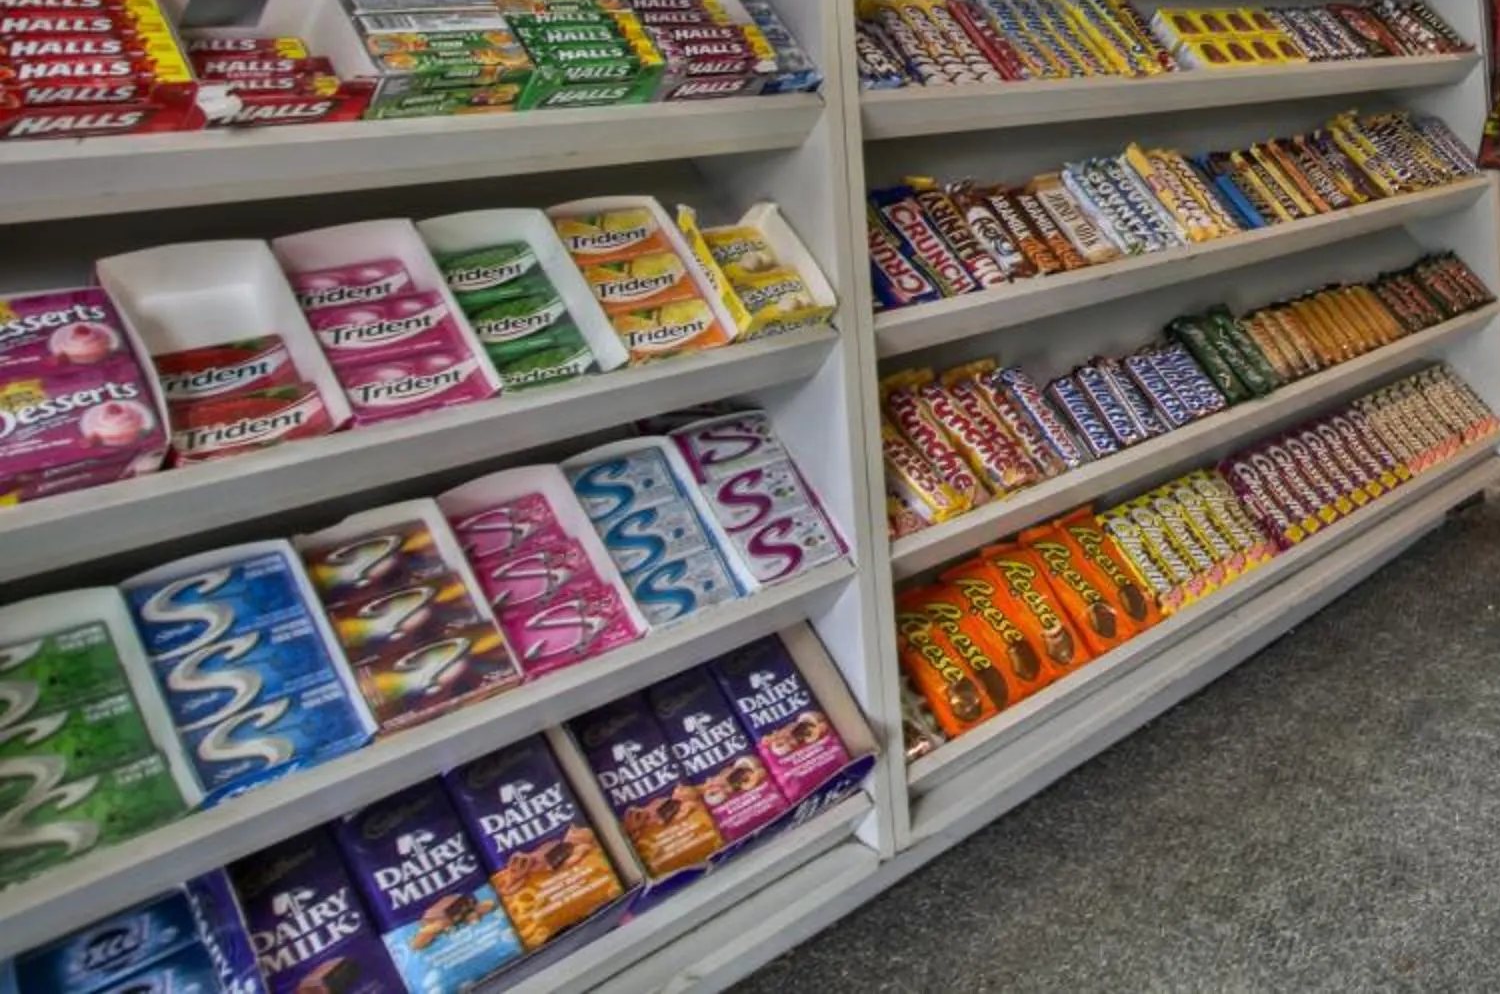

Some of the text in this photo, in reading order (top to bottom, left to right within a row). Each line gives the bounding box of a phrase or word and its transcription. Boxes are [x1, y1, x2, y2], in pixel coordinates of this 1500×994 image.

[1, 16, 112, 33] HALLS
[642, 11, 702, 23] HALLS
[674, 25, 733, 40] HALLS
[10, 38, 122, 57] HALLS
[189, 38, 258, 52] ALLS
[545, 27, 613, 43] HALLS
[682, 41, 744, 55] HALLS
[19, 60, 131, 78] HALLS
[205, 58, 296, 74] HALLS
[557, 45, 625, 62] HALLS
[685, 60, 747, 75] HALLS
[226, 77, 296, 90] ALLS
[564, 63, 632, 79] HALLS
[24, 85, 138, 104] HALLS
[547, 85, 632, 105] HALLS
[671, 78, 747, 98] HALLS
[7, 111, 146, 138] HALLS
[571, 227, 648, 249] Trident
[890, 205, 974, 294] CRUNCH
[448, 264, 522, 283] rident
[869, 229, 926, 293] CRUN
[598, 272, 676, 297] Trident
[331, 314, 435, 345] Trident
[628, 320, 705, 346] Trident
[358, 369, 461, 403] Trident
[185, 409, 305, 450] Trident
[1069, 527, 1127, 585] Reese
[1034, 542, 1101, 603] Reese
[955, 578, 1023, 644] Reese
[997, 560, 1059, 630] Reese
[896, 612, 964, 683] Reese
[926, 603, 991, 670] Reese
[737, 673, 800, 714] DAIRY
[750, 694, 810, 730] MILK
[672, 716, 738, 759] DAIRY
[599, 743, 672, 789] DAIRY
[681, 737, 746, 778] MILK
[612, 767, 677, 806] MILK
[479, 782, 565, 836] DAIRY
[493, 806, 573, 854] MILK
[373, 832, 466, 892] DAIRY
[388, 857, 476, 911] MILK
[249, 888, 349, 954] DAIRY
[256, 913, 359, 977] MILK
